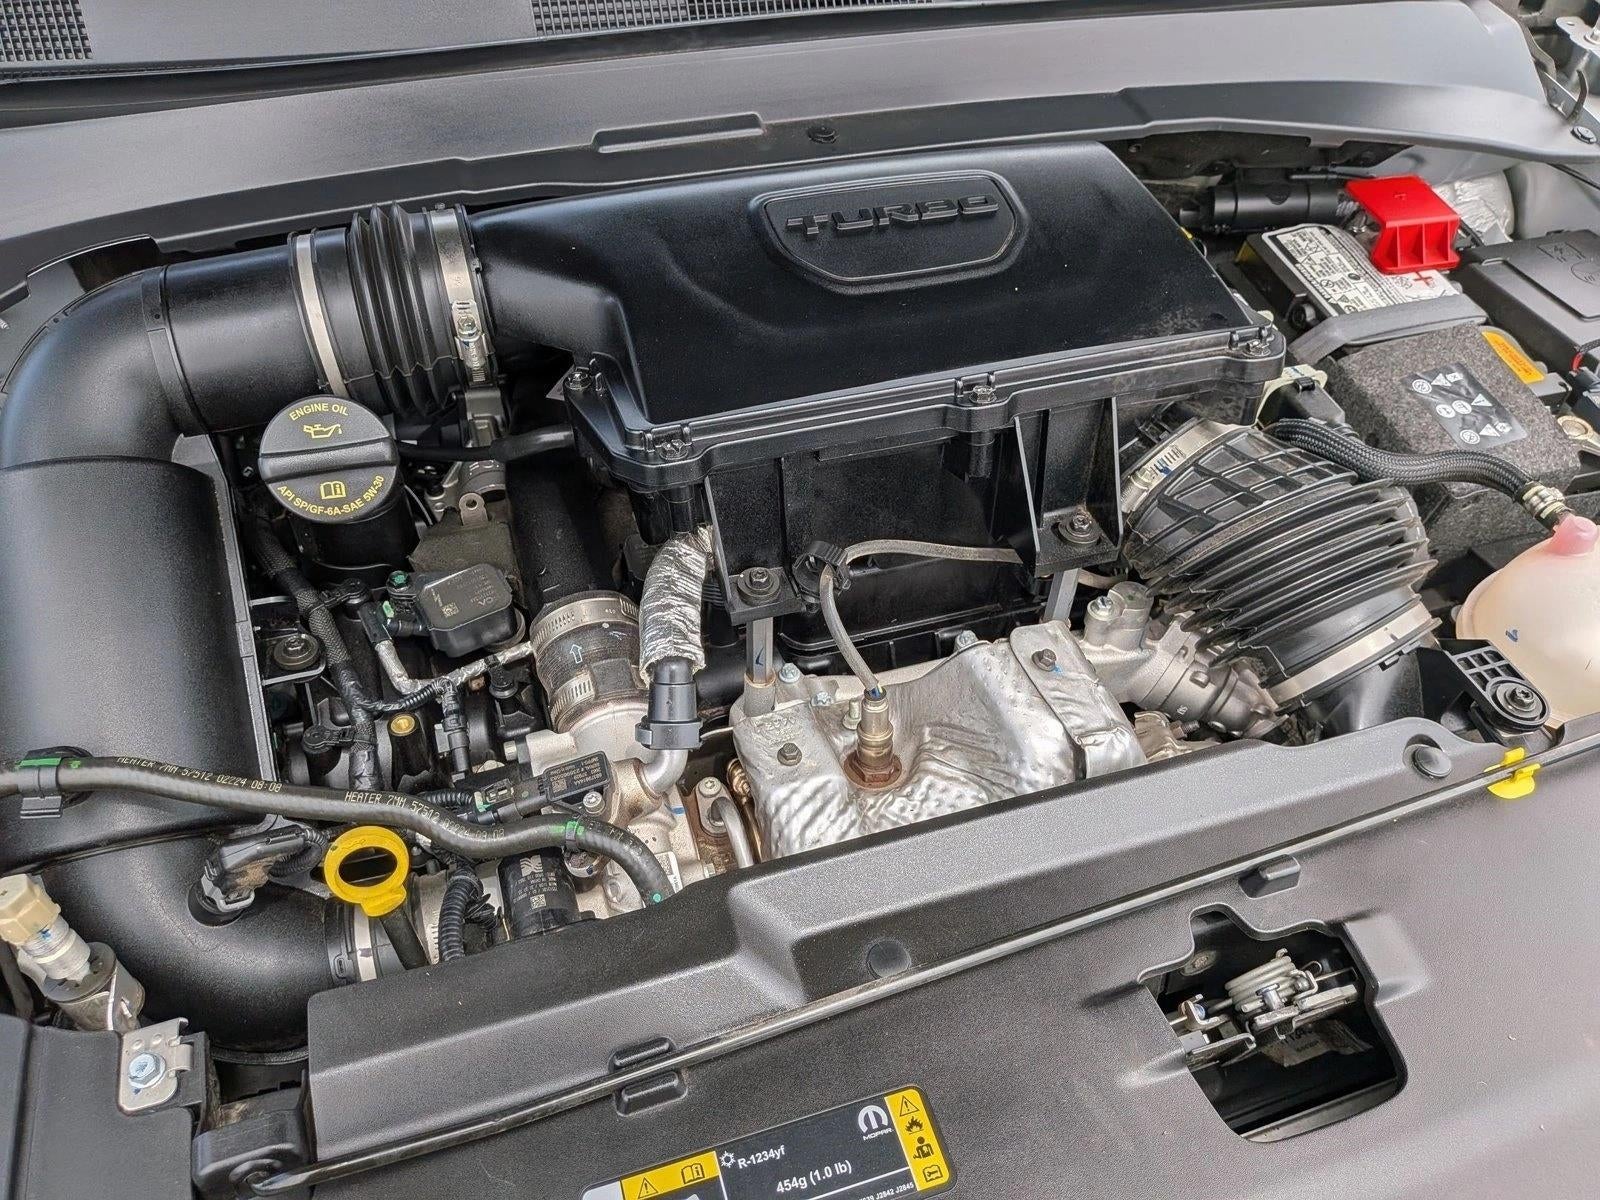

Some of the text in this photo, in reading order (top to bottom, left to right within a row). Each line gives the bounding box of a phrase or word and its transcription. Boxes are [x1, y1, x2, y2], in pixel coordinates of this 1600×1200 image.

[786, 195, 999, 236] TURBO
[289, 403, 350, 421] ENGINE OIL
[277, 485, 295, 501] API
[363, 475, 384, 502] 5W-30
[116, 756, 155, 768] HEATER
[217, 774, 247, 787] 02224
[251, 779, 283, 793] 08:08
[344, 791, 382, 805] HEATER
[386, 795, 407, 809] 7MM
[410, 800, 439, 823] 57512
[863, 1127, 894, 1141] MOPAR
[738, 1145, 785, 1169] R-1234yf
[776, 1160, 852, 1193] 454g (1.0 lb)
